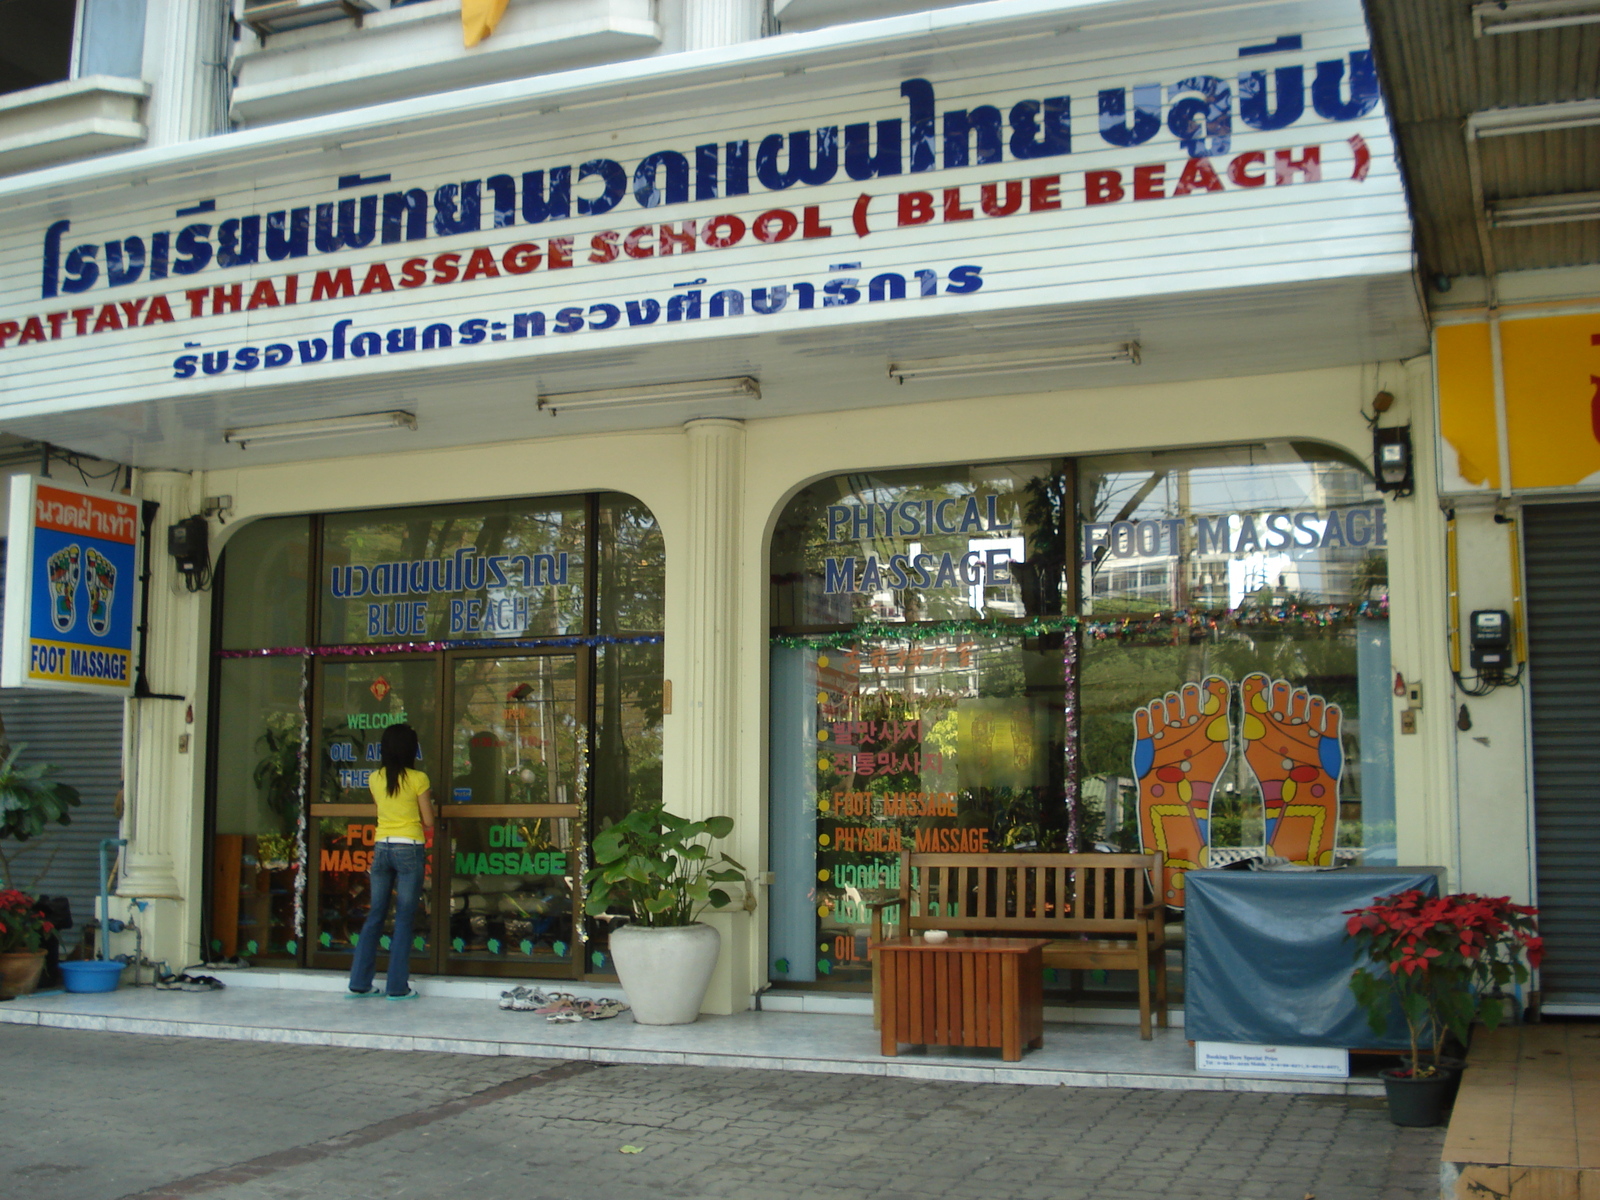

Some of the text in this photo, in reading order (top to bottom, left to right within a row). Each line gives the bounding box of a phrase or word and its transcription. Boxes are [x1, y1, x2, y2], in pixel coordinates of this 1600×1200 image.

[0, 294, 175, 348] PATTAYA
[186, 274, 298, 319] THAI
[310, 236, 575, 302] MASSAGE
[587, 204, 832, 265] SCHOOL
[897, 175, 1061, 228] BLUE
[1084, 144, 1322, 207] BEACH
[36, 499, 135, 538] นวดฝ่าเท้า
[826, 494, 1013, 541] PHYSICAL
[1083, 516, 1186, 562] FOOT
[331, 547, 569, 598] นวดแผนโบราณ
[824, 548, 1013, 594] MASSAGE
[367, 597, 529, 637] BLUE BEACH
[31, 645, 126, 680] FOOT MASSAGE
[347, 712, 408, 730] WELCOME
[833, 720, 923, 745] 발맛사지
[330, 742, 358, 762] OIL
[833, 752, 943, 776] 전통맛사지
[834, 792, 958, 816] FOOT MASSAGE
[489, 826, 527, 847] OIL
[834, 828, 989, 852] PHYSICAL MASSAGE
[455, 852, 566, 875] MASSAGE
[835, 936, 860, 961] OIL
